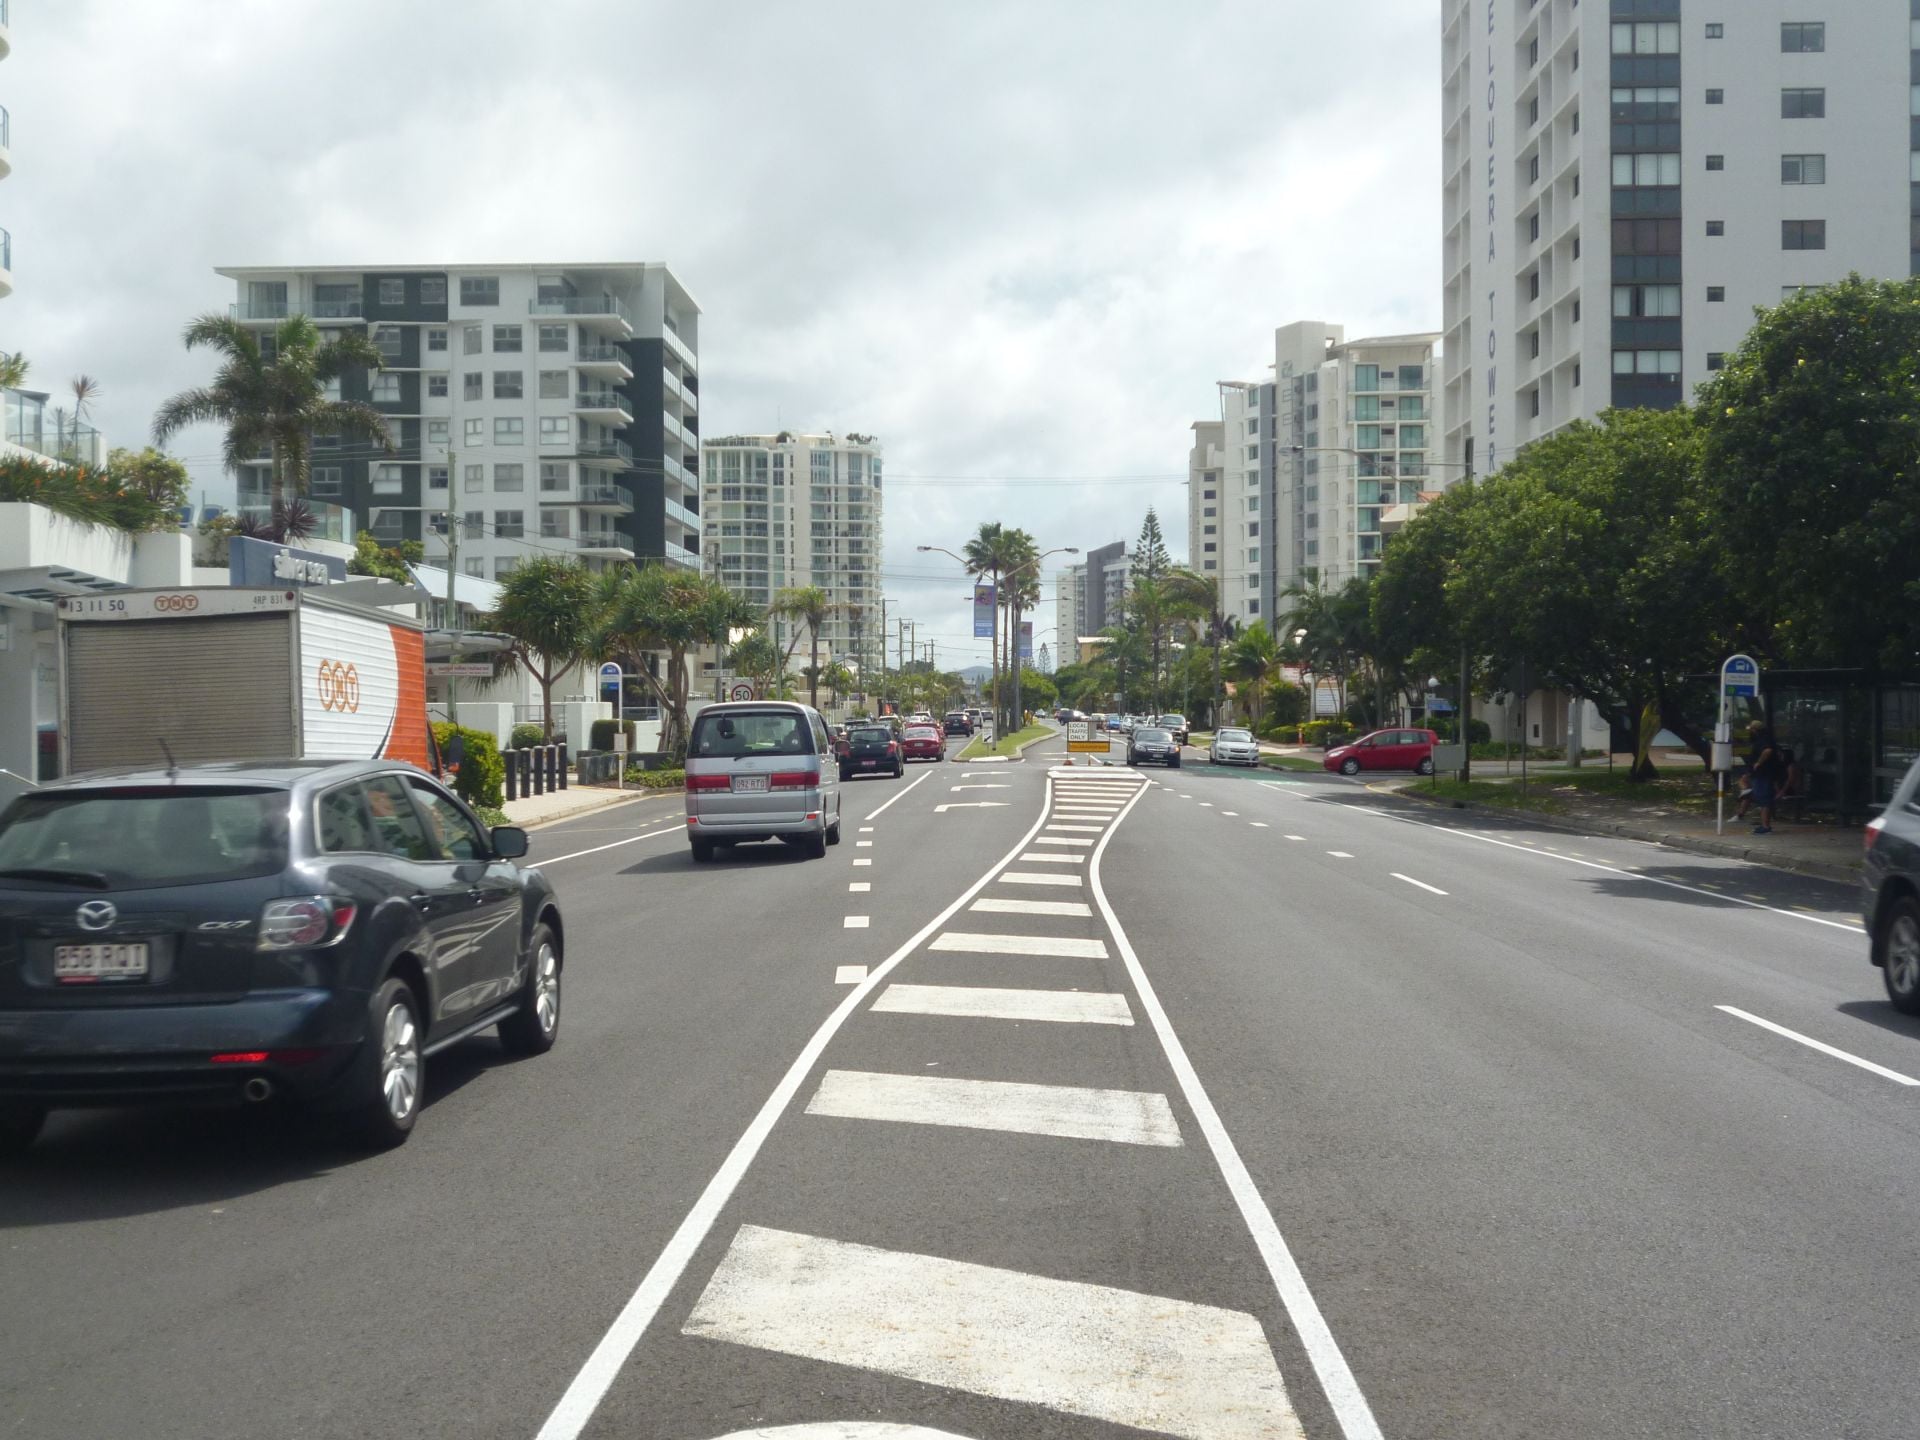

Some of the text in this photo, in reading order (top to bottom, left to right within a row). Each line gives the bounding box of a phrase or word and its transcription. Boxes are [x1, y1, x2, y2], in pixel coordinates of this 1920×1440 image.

[1488, 290, 1496, 473] TOWER
[69, 599, 125, 612] 13 11 50
[154, 594, 199, 611] TNT
[319, 659, 359, 713] TNT
[735, 690, 750, 701] 50
